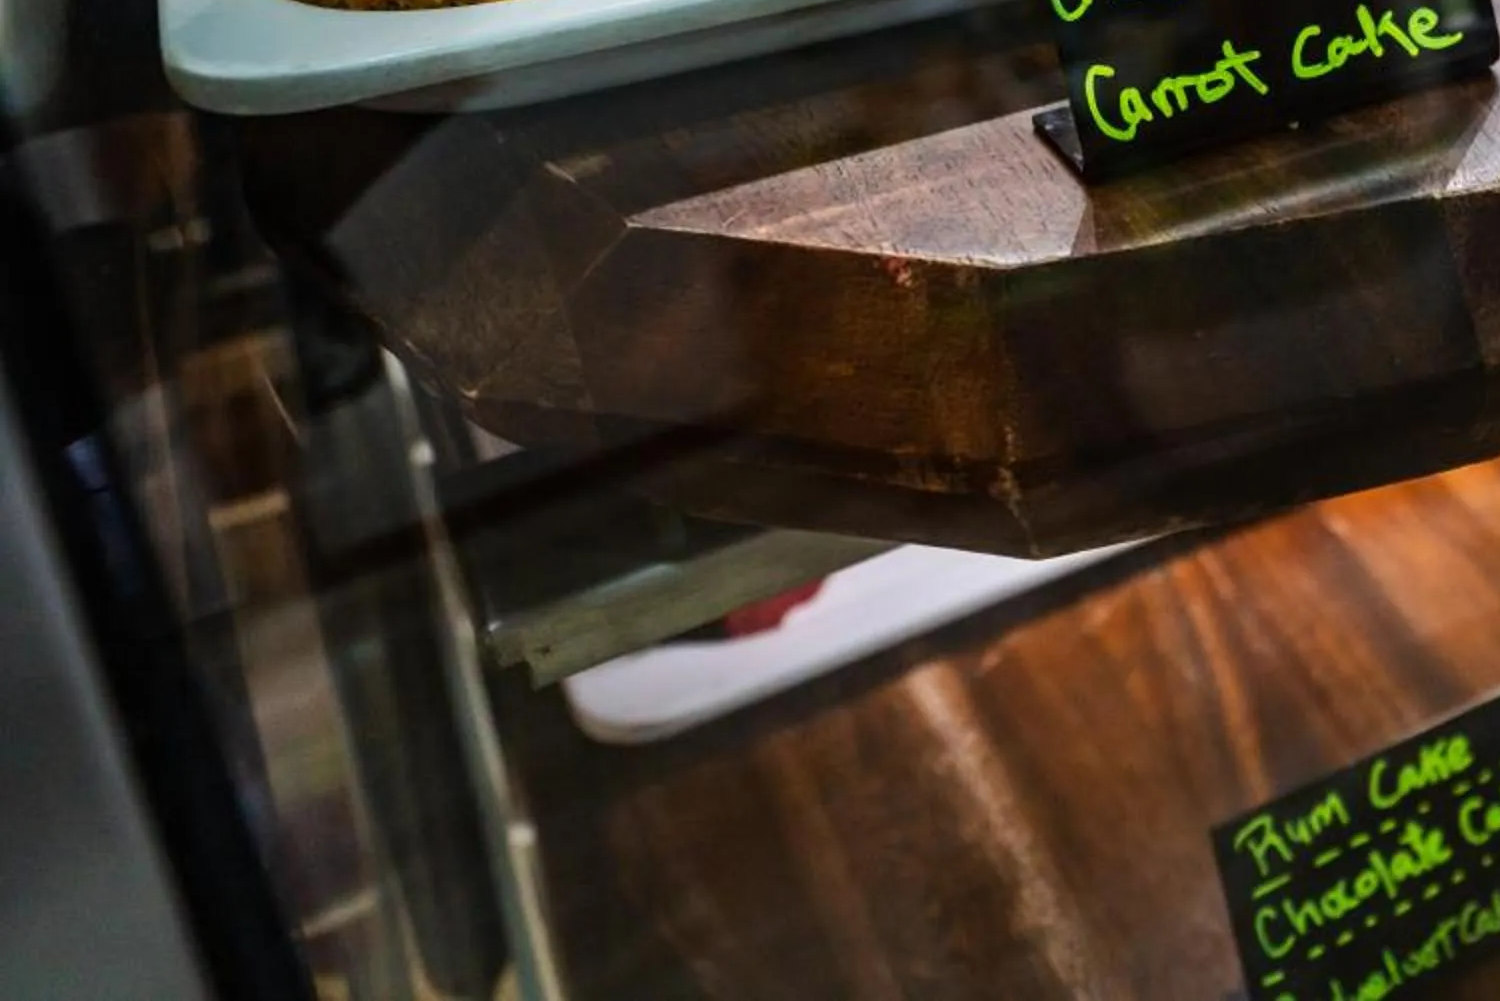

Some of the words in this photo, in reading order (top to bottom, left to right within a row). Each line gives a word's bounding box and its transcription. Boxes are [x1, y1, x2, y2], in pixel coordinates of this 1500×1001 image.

[1084, 40, 1269, 141] Carrot
[1292, 4, 1464, 79] Cake
[1234, 792, 1350, 876] Rum
[1369, 734, 1474, 809] Cake
[1254, 821, 1452, 959] Chocolate
